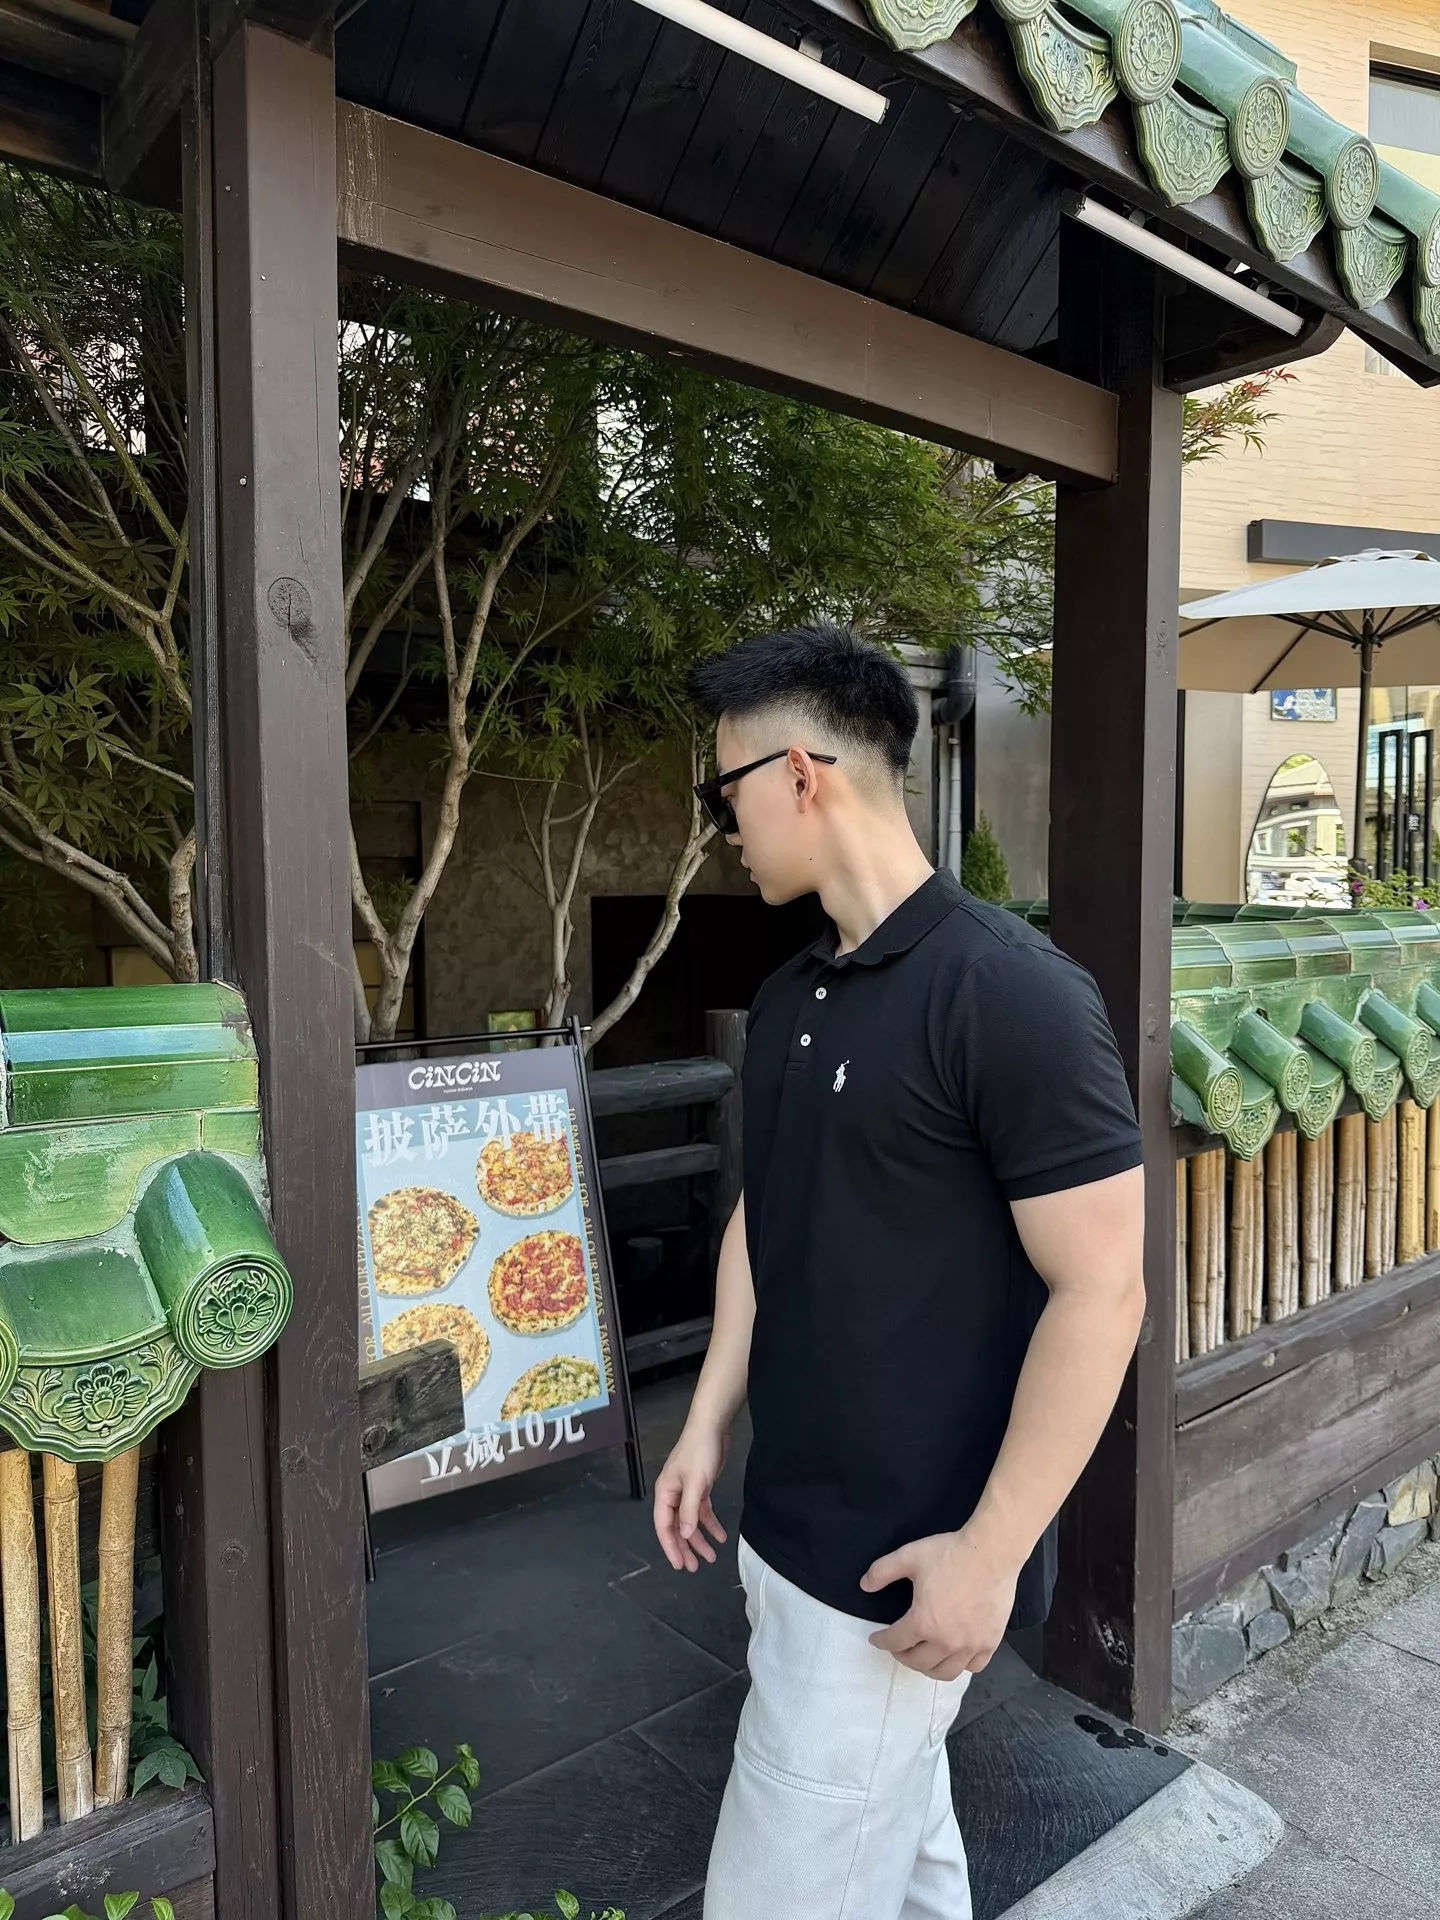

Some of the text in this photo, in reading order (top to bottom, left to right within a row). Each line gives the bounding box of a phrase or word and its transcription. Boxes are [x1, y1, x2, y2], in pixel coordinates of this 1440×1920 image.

[363, 1093, 568, 1167] 披萨外带
[358, 1263, 370, 1299] OUR
[568, 1107, 617, 1394] 10 RMB OFF FOR ALL OUR PIZZAS TAKEAWAY
[362, 1305, 373, 1325] ALL
[420, 1402, 585, 1483] 立减10元
